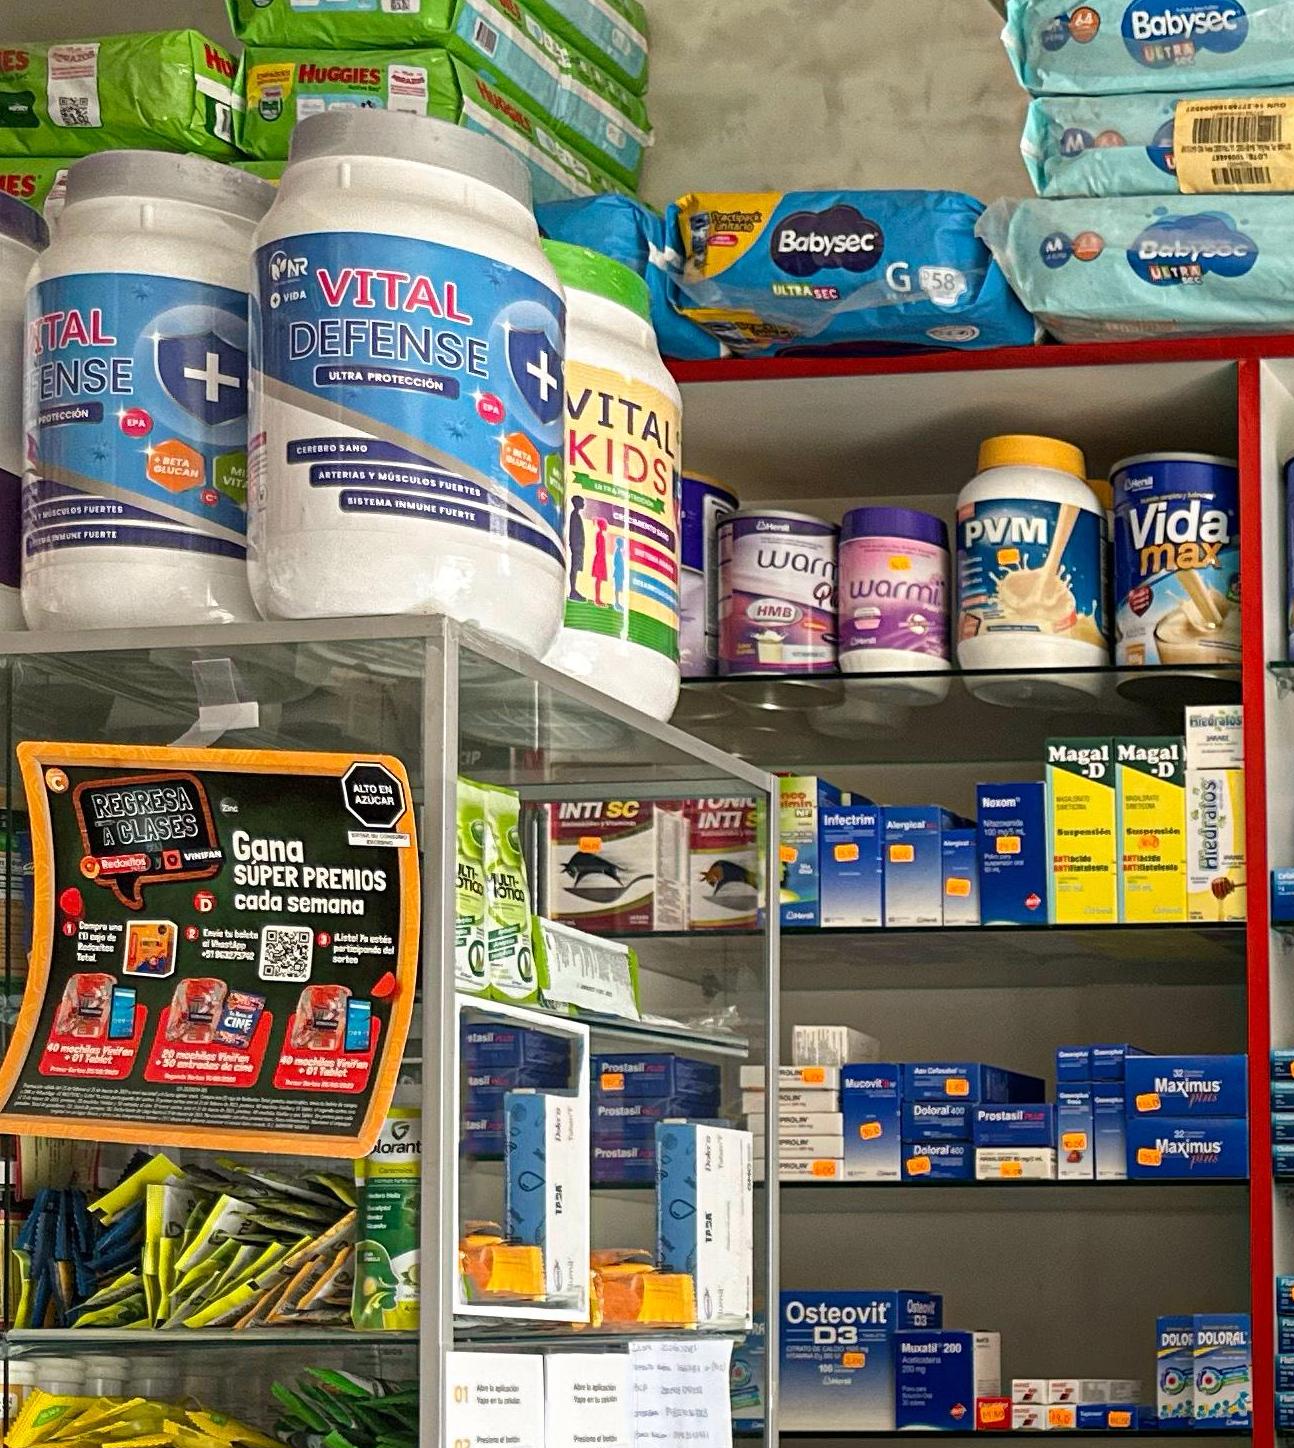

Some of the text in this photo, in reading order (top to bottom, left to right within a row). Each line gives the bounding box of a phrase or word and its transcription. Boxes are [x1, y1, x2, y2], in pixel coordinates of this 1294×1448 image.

[1131, 6, 1239, 42] Babysec
[298, 64, 381, 87] HUGGIES
[777, 226, 878, 257] Babysec
[283, 289, 308, 302] VIDA
[317, 266, 472, 325] VITAL
[289, 319, 489, 379] DEFENSE
[328, 369, 445, 392] ULTRA PROTECCIÓN
[296, 442, 369, 456] CEREBRO SANO
[566, 435, 672, 495] KIDS
[317, 469, 364, 483] ARTERIAS
[377, 472, 436, 490] MÚSCULOS
[438, 480, 482, 498] FUERTES
[964, 516, 1048, 549] PVM
[1130, 500, 1231, 550] Vida
[1140, 540, 1222, 577] max
[756, 604, 793, 620] HMB
[1047, 745, 1109, 764] Magal
[1081, 762, 1107, 780] -D
[352, 783, 394, 796] ALTO EN
[354, 793, 396, 807] AZÚCAR
[91, 787, 194, 820] REGRESA
[102, 814, 199, 846] A CLASES
[823, 813, 876, 828] Infectrim
[231, 829, 304, 865] Gana
[233, 861, 388, 893] SÚPER PREMIOS
[233, 892, 366, 917] cada semana
[1154, 1076, 1221, 1099] Maximus
[785, 1301, 888, 1327] Osteovit
[813, 1326, 858, 1344] D3
[1197, 1331, 1246, 1346] DOLORAL
